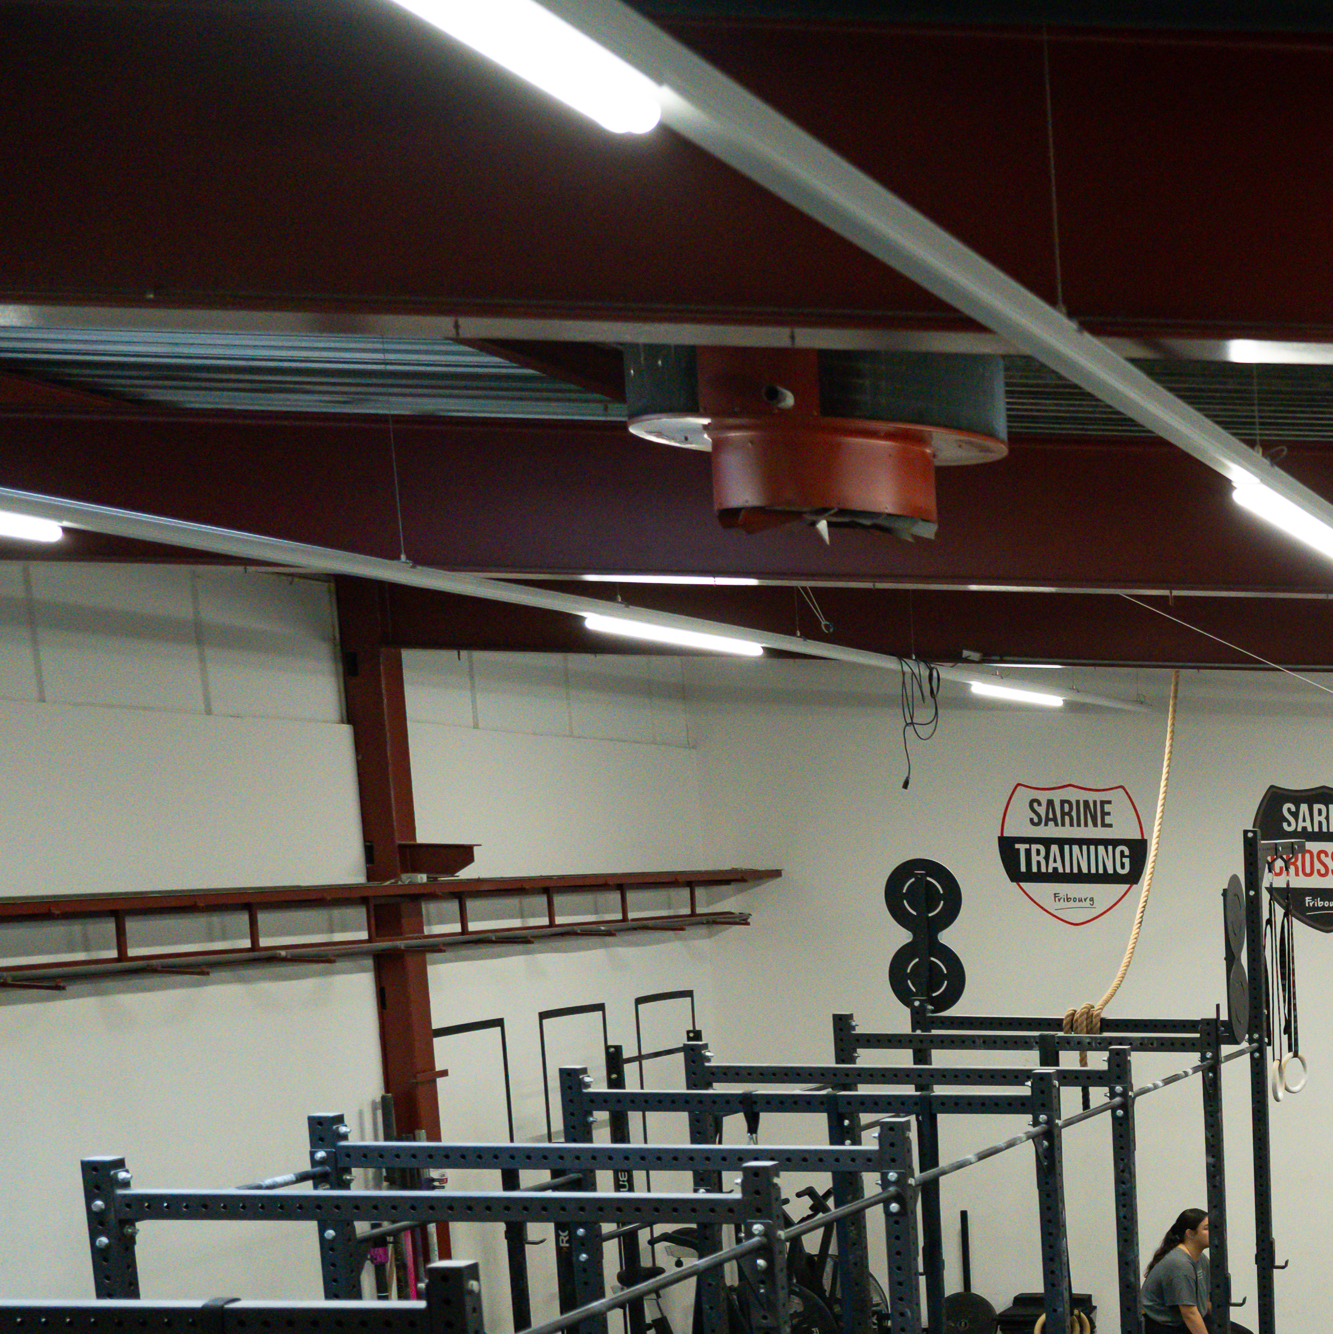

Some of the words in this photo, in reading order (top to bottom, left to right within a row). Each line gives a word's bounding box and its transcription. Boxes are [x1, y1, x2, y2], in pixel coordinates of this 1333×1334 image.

[1028, 798, 1113, 828] SARINE
[1014, 843, 1131, 875] TRAINING
[1053, 892, 1096, 906] Fribourg
